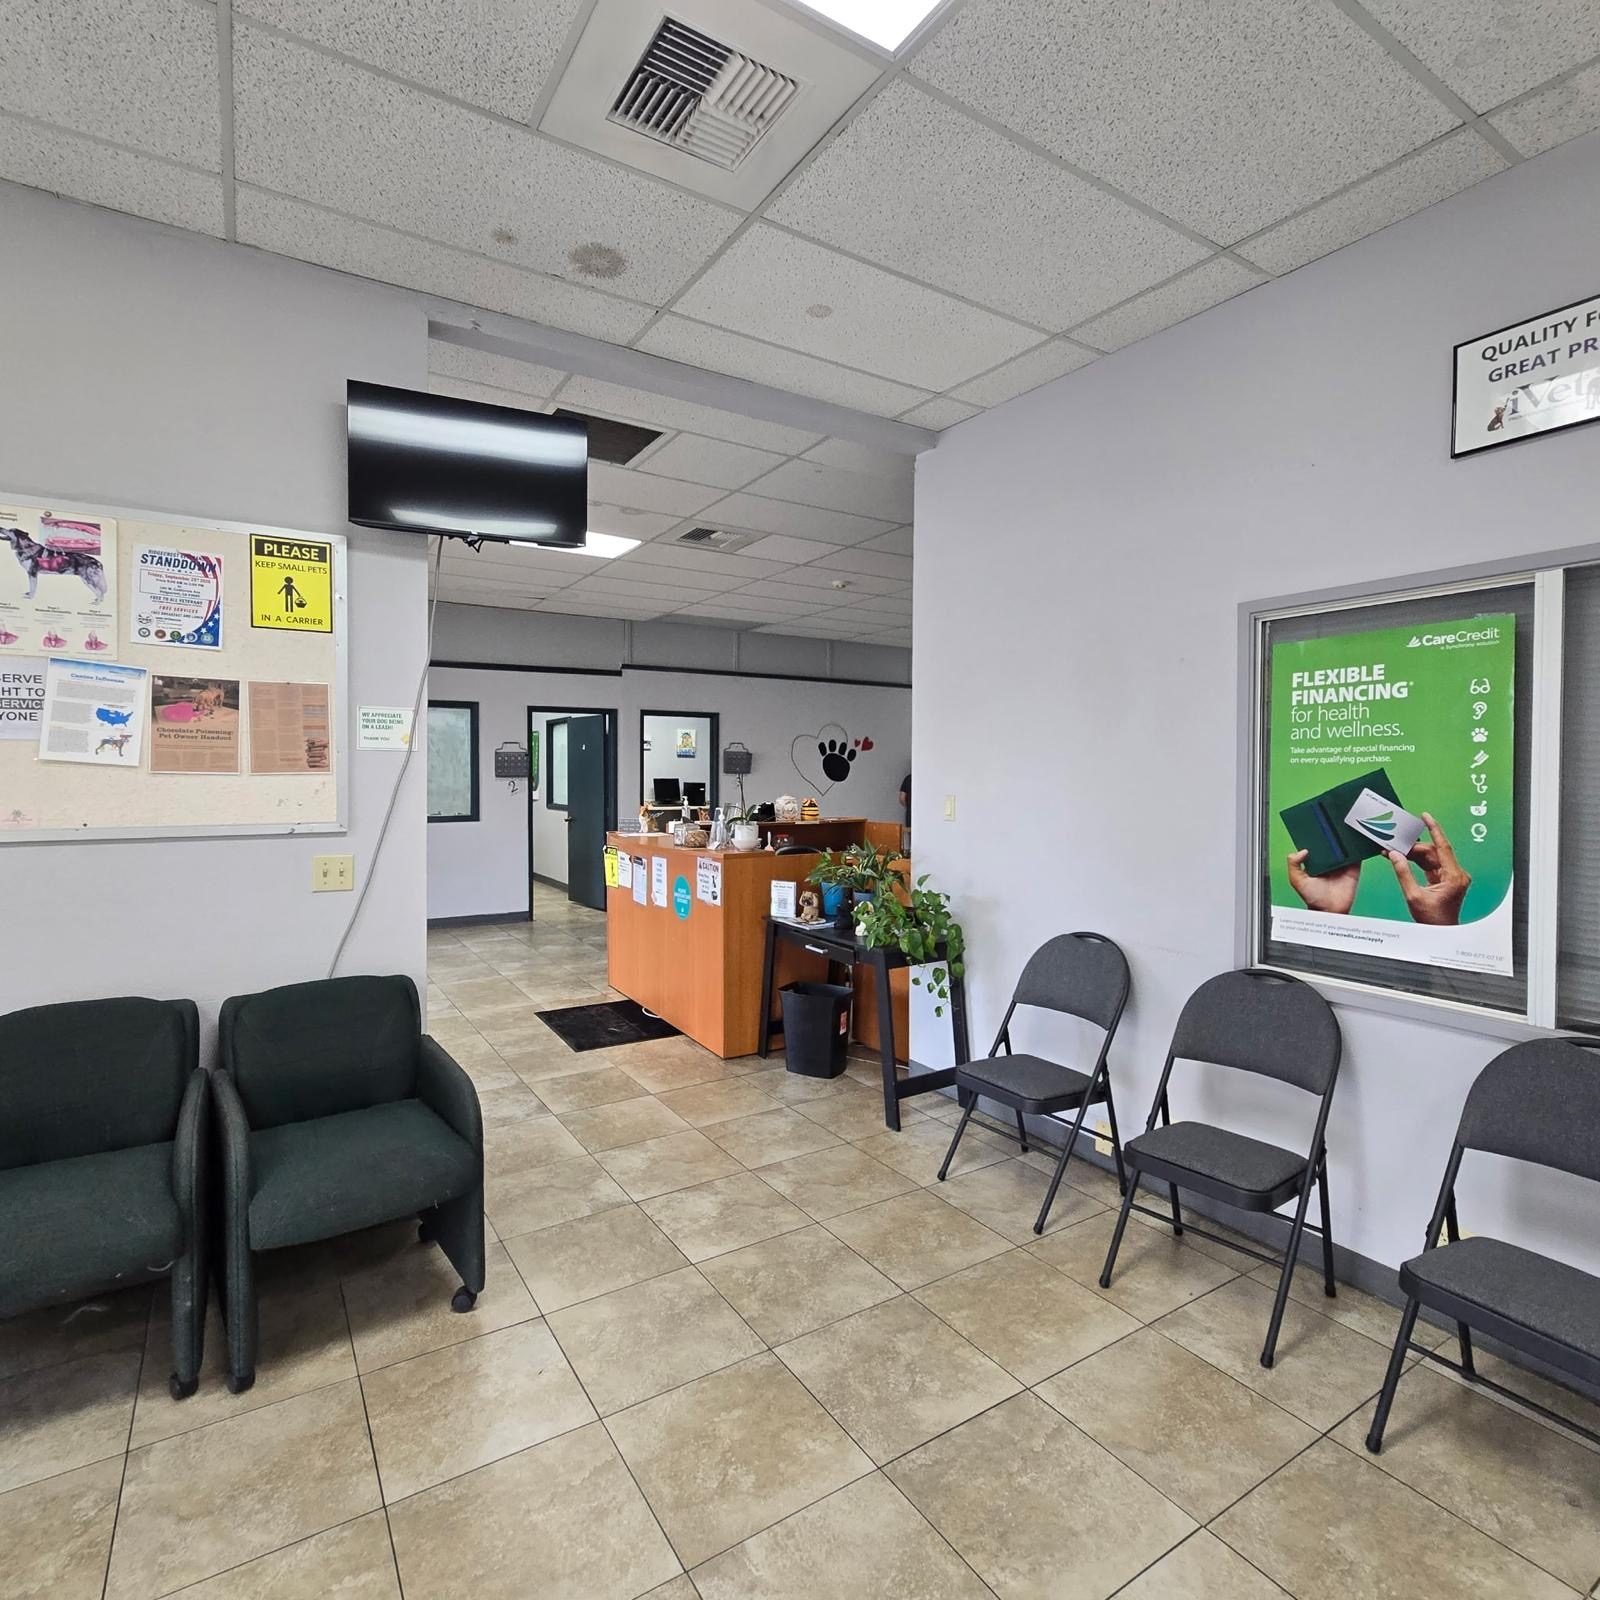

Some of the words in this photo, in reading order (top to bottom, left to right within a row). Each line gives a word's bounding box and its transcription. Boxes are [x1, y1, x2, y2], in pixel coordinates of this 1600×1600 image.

[1481, 316, 1578, 362] QUALITY
[1586, 310, 1600, 327] F
[1488, 348, 1561, 382] GREAT
[264, 543, 319, 560] PLEASE
[140, 553, 216, 573] STANDDOWN
[255, 560, 276, 568] KEEP
[278, 562, 306, 572] SMALL
[307, 565, 327, 575] PETS
[286, 616, 323, 626] CARRIER
[1422, 627, 1500, 646] CareCredit
[0, 673, 42, 684] ERVE
[1292, 664, 1385, 688] FLEXIBLE
[25, 687, 45, 697] TO
[1291, 706, 1313, 723] for
[1318, 703, 1370, 722] health
[1290, 723, 1321, 740] and
[1327, 721, 1404, 738] wellness.
[1306, 746, 1341, 755] advantage
[1352, 745, 1378, 753] special
[1379, 744, 1415, 752] financing
[1320, 755, 1355, 764] qualifying
[1356, 755, 1392, 763] purchase.
[508, 780, 518, 793] 2
[1328, 931, 1384, 943] carecredit.com/apply
